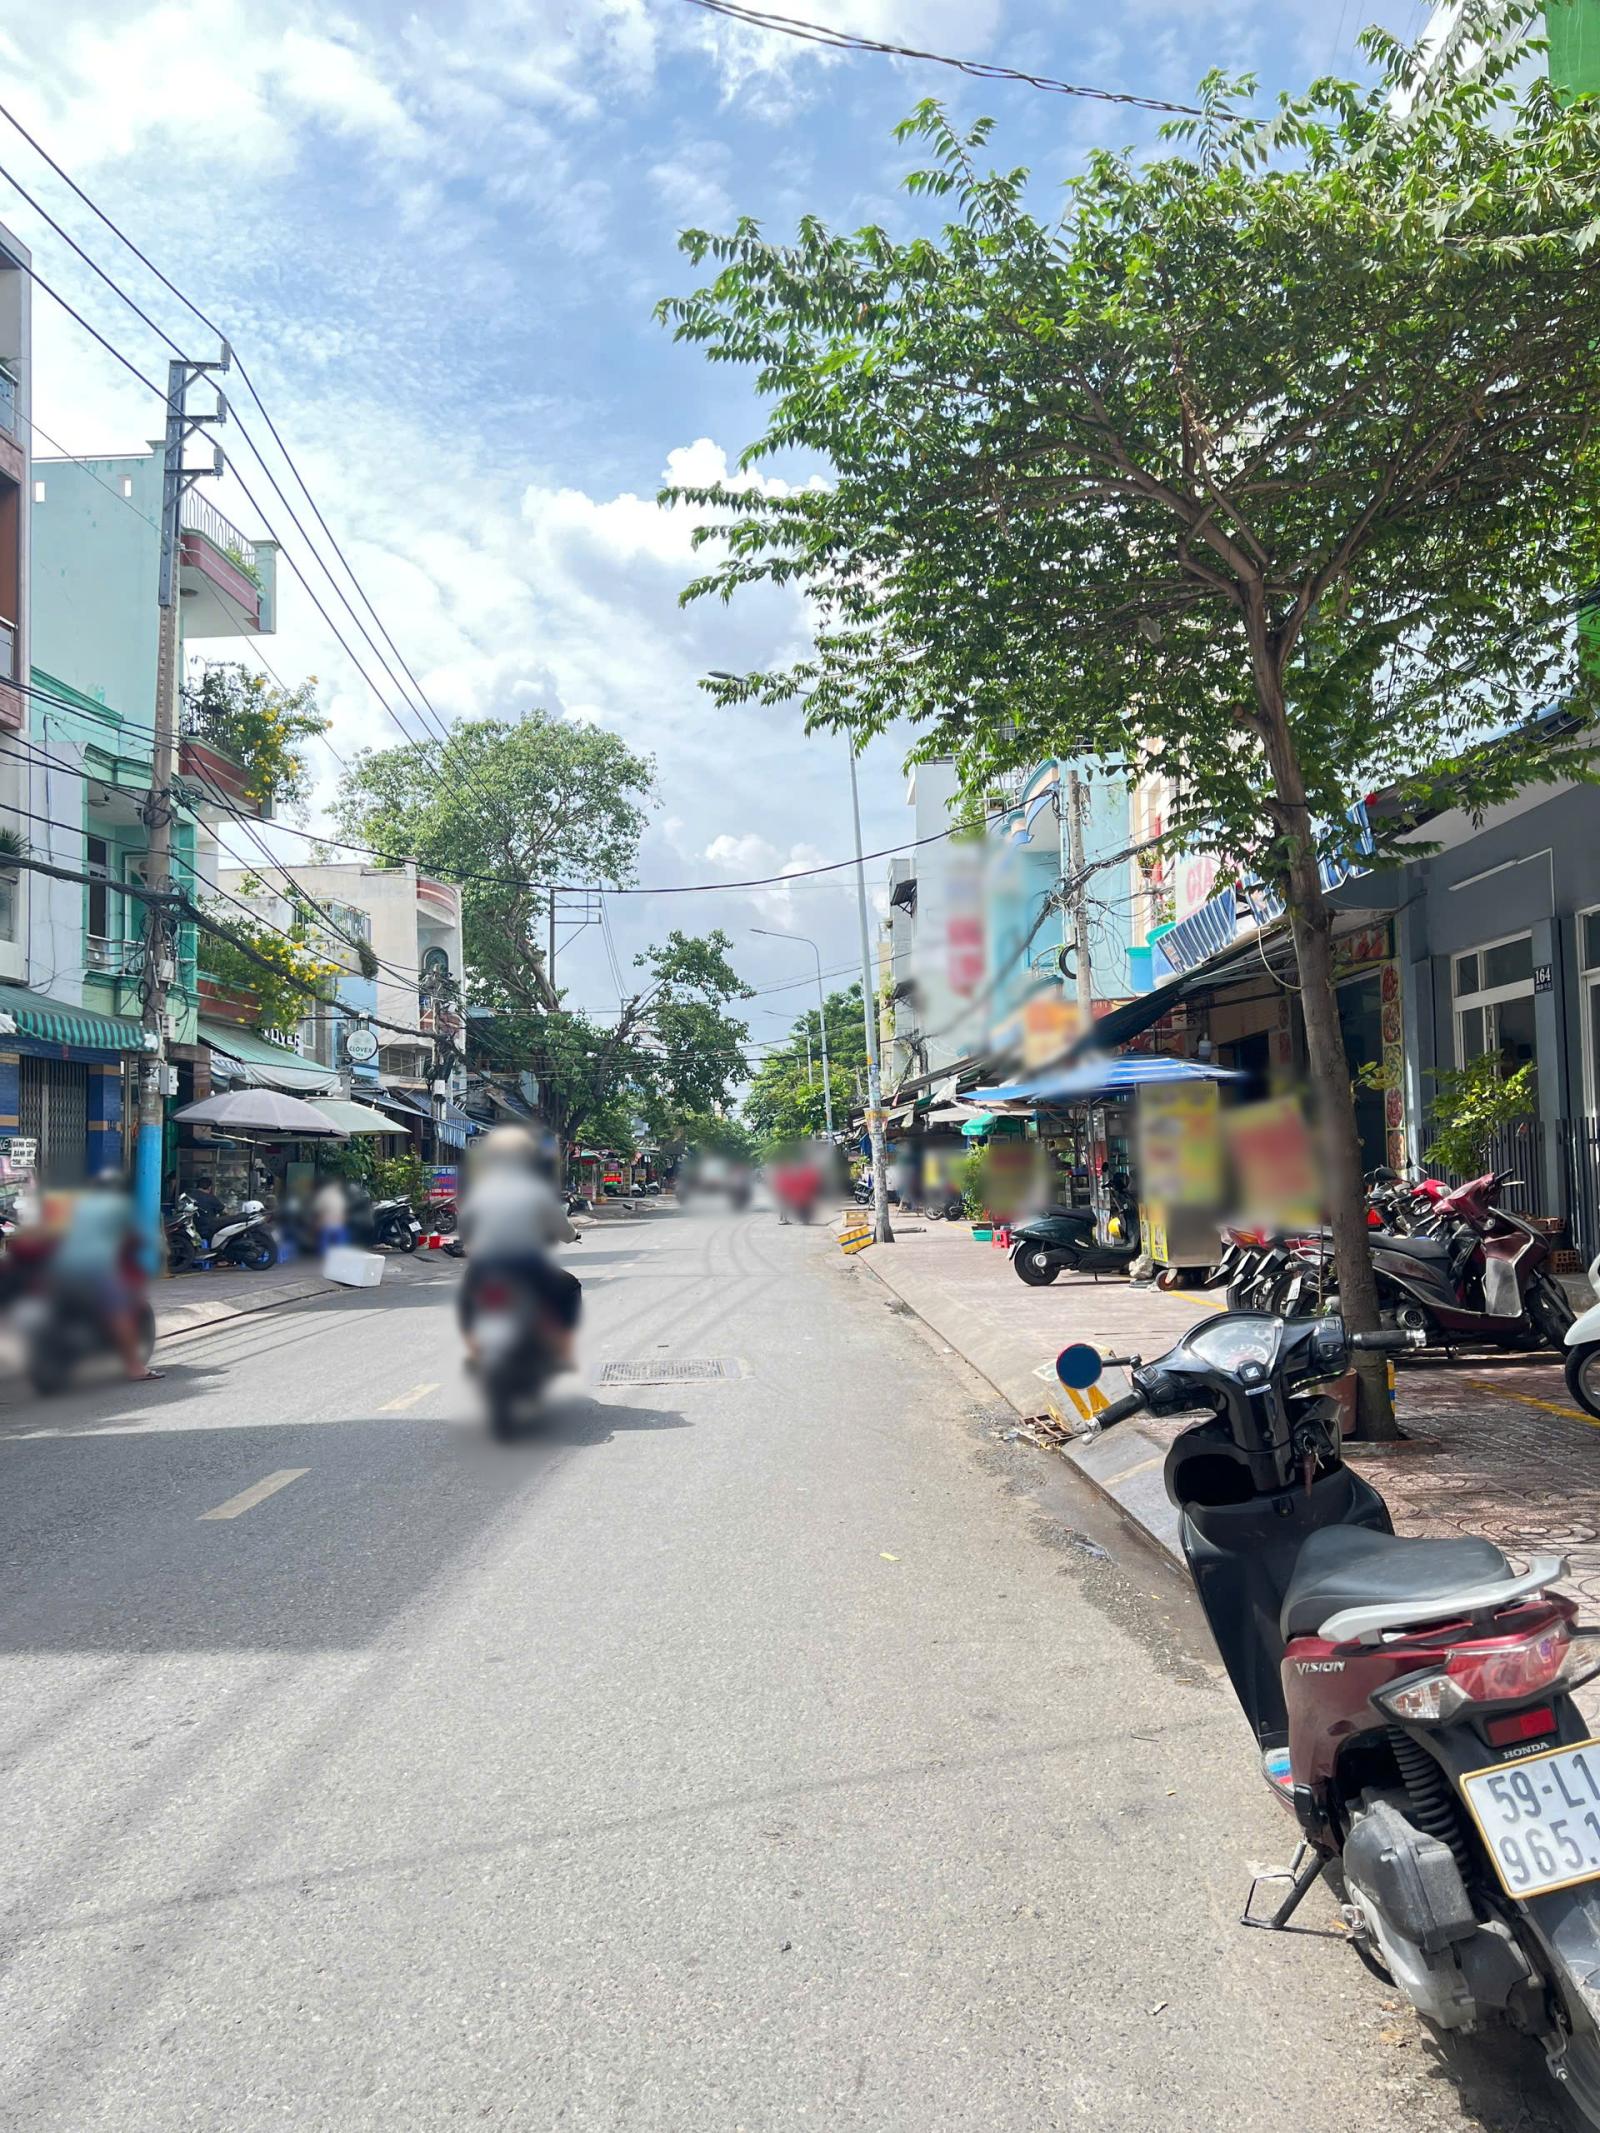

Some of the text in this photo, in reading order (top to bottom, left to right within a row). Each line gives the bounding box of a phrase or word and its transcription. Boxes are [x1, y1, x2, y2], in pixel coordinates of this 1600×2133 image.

[1535, 967, 1551, 984] 164
[1296, 1661, 1345, 1675] VISION
[1503, 1742, 1549, 1759] HONDA
[1487, 1754, 1600, 1824] 59-L1
